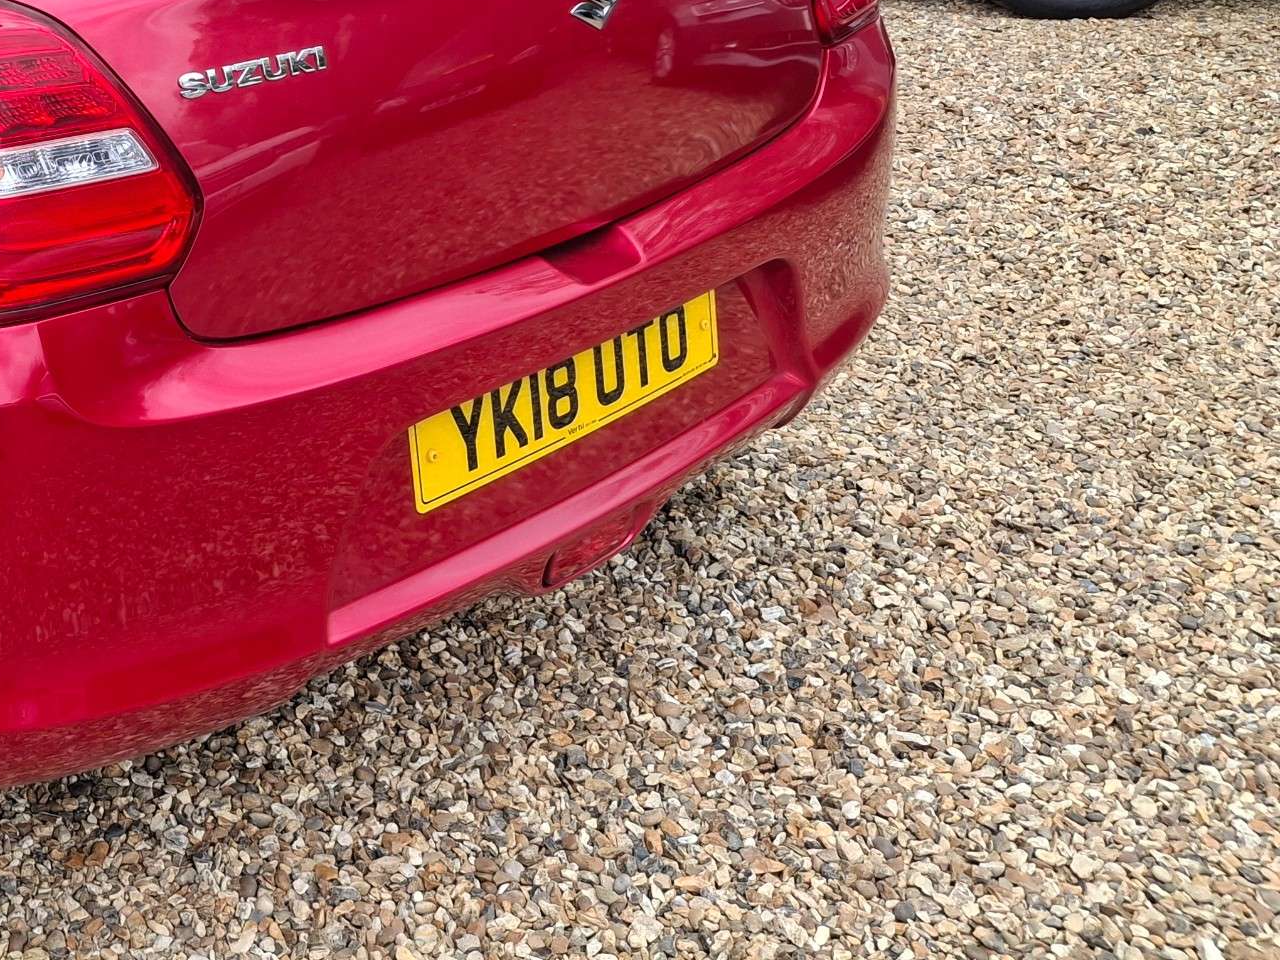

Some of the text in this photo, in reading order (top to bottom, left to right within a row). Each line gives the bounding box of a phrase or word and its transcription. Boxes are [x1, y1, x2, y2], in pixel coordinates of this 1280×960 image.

[177, 45, 327, 100] SUZUKI
[450, 305, 688, 472] YK18 UTO
